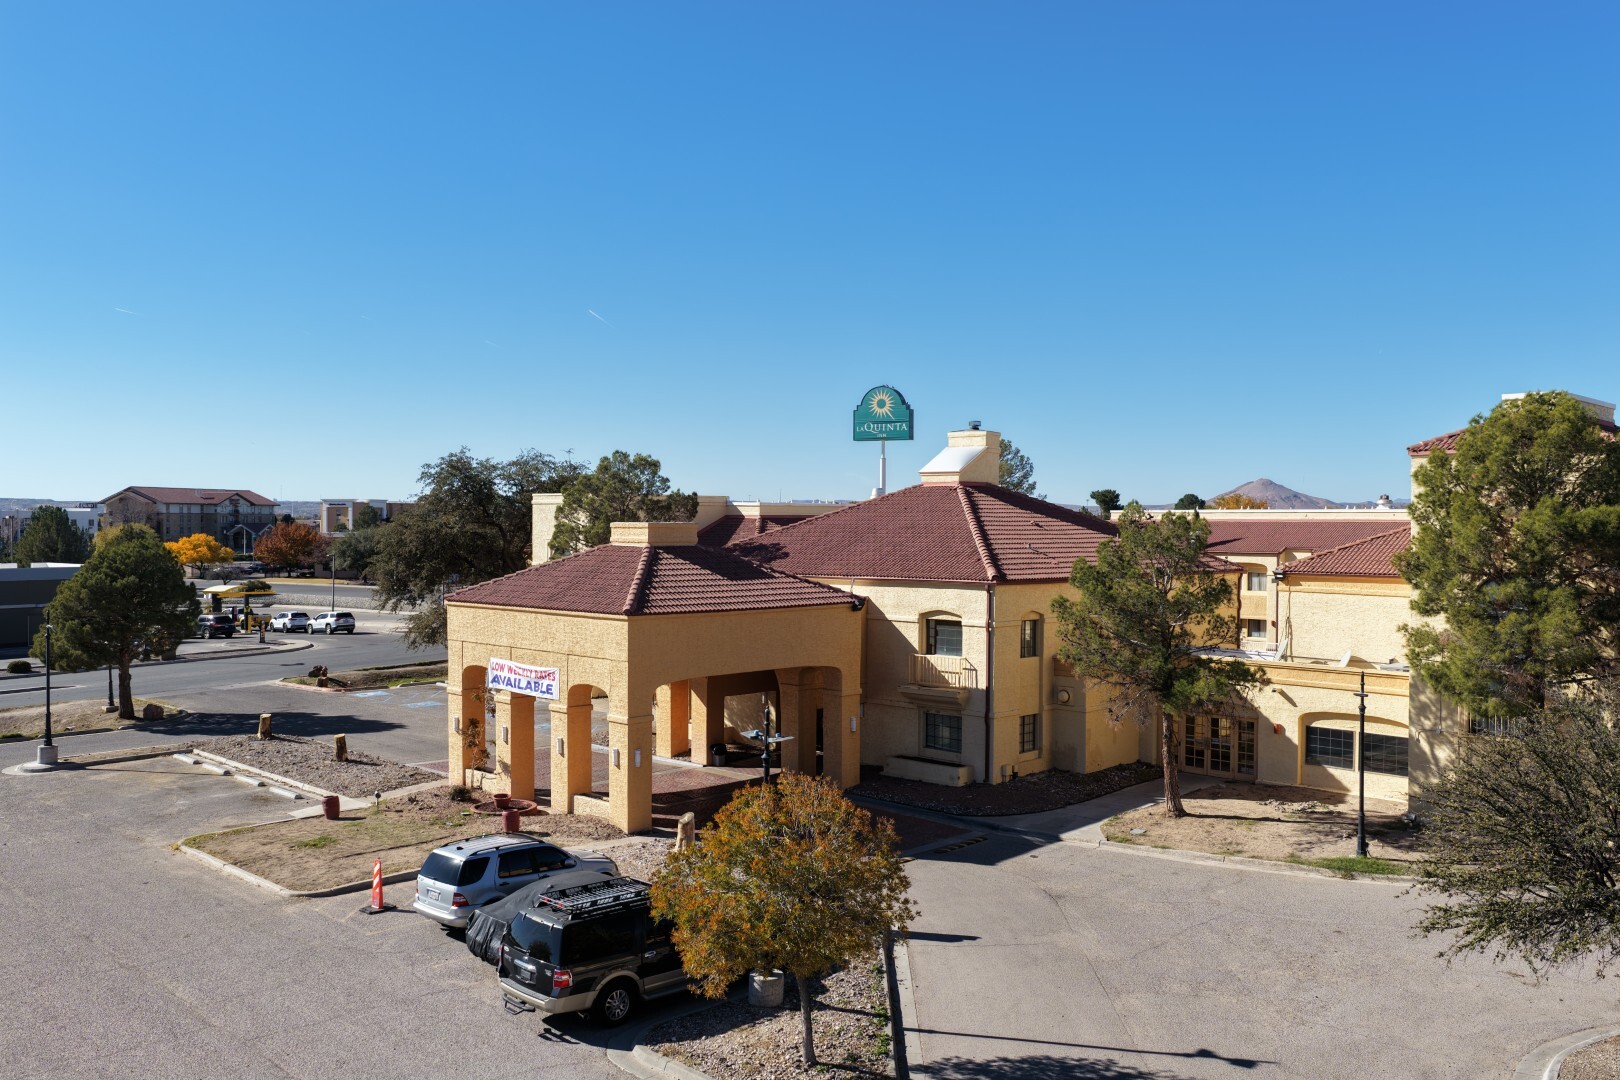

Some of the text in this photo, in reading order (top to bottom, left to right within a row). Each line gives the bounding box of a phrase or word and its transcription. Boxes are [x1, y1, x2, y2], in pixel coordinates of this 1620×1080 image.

[864, 422, 908, 433] QUINTA
[492, 662, 556, 682] LOW WEEKLY RATES
[490, 674, 554, 695] AVAILABLE
